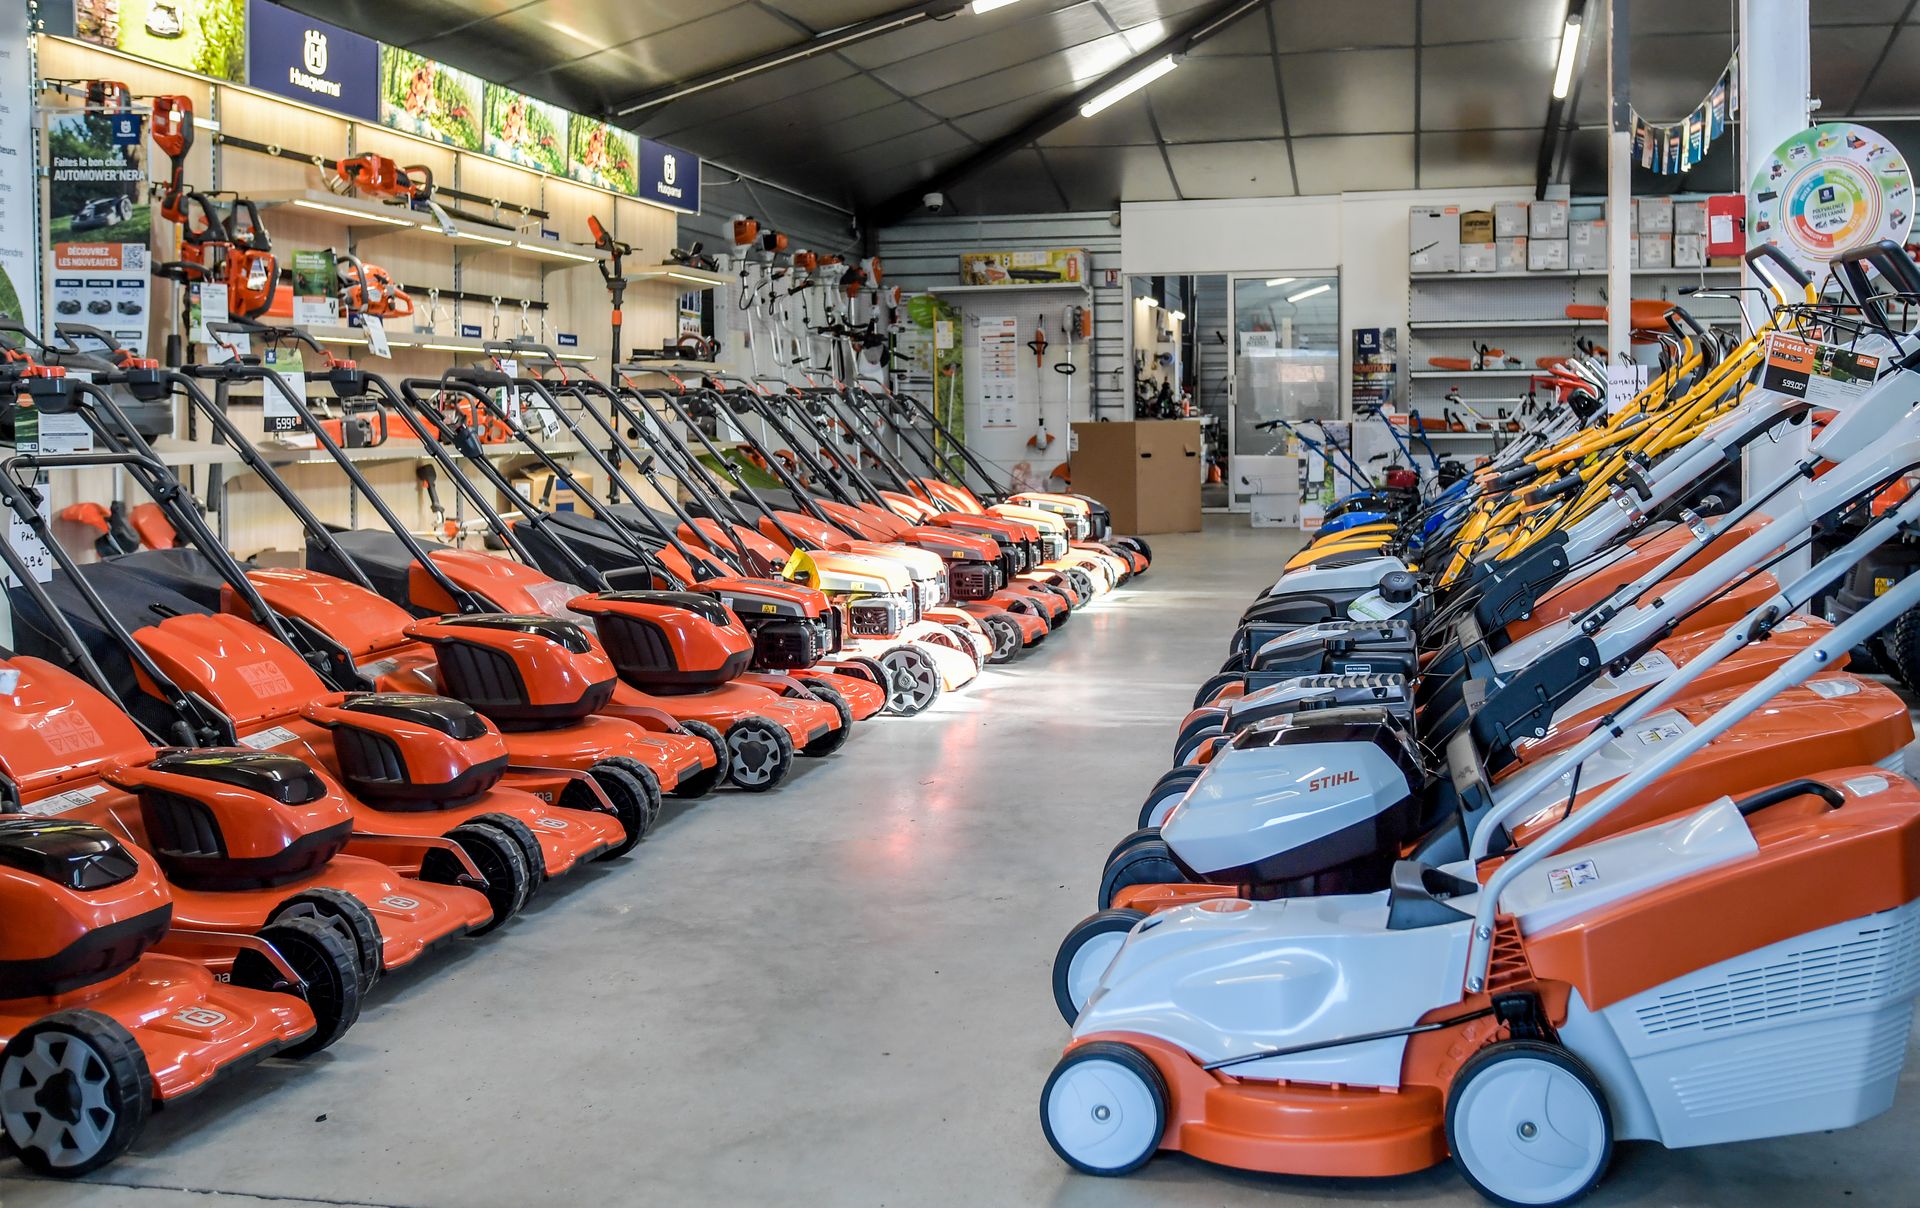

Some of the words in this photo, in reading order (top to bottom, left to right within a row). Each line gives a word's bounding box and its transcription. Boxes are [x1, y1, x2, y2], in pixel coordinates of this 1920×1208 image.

[289, 66, 342, 97] Husqvarna
[54, 157, 78, 167] Faites
[79, 157, 87, 167] le
[88, 157, 104, 167] bon
[105, 157, 127, 167] choix
[657, 181, 682, 198] Husqvarna
[1812, 202, 1844, 215] POLYVALENCE
[68, 246, 110, 256] DÉCOUVREZ
[59, 258, 71, 267] LES
[72, 257, 118, 267] NOUVEAUTÉS
[1773, 340, 1785, 349] RM
[1803, 347, 1814, 355] TC
[1859, 358, 1875, 366] STIHL
[21, 531, 40, 542] PAC
[1309, 770, 1360, 793] STIHL
